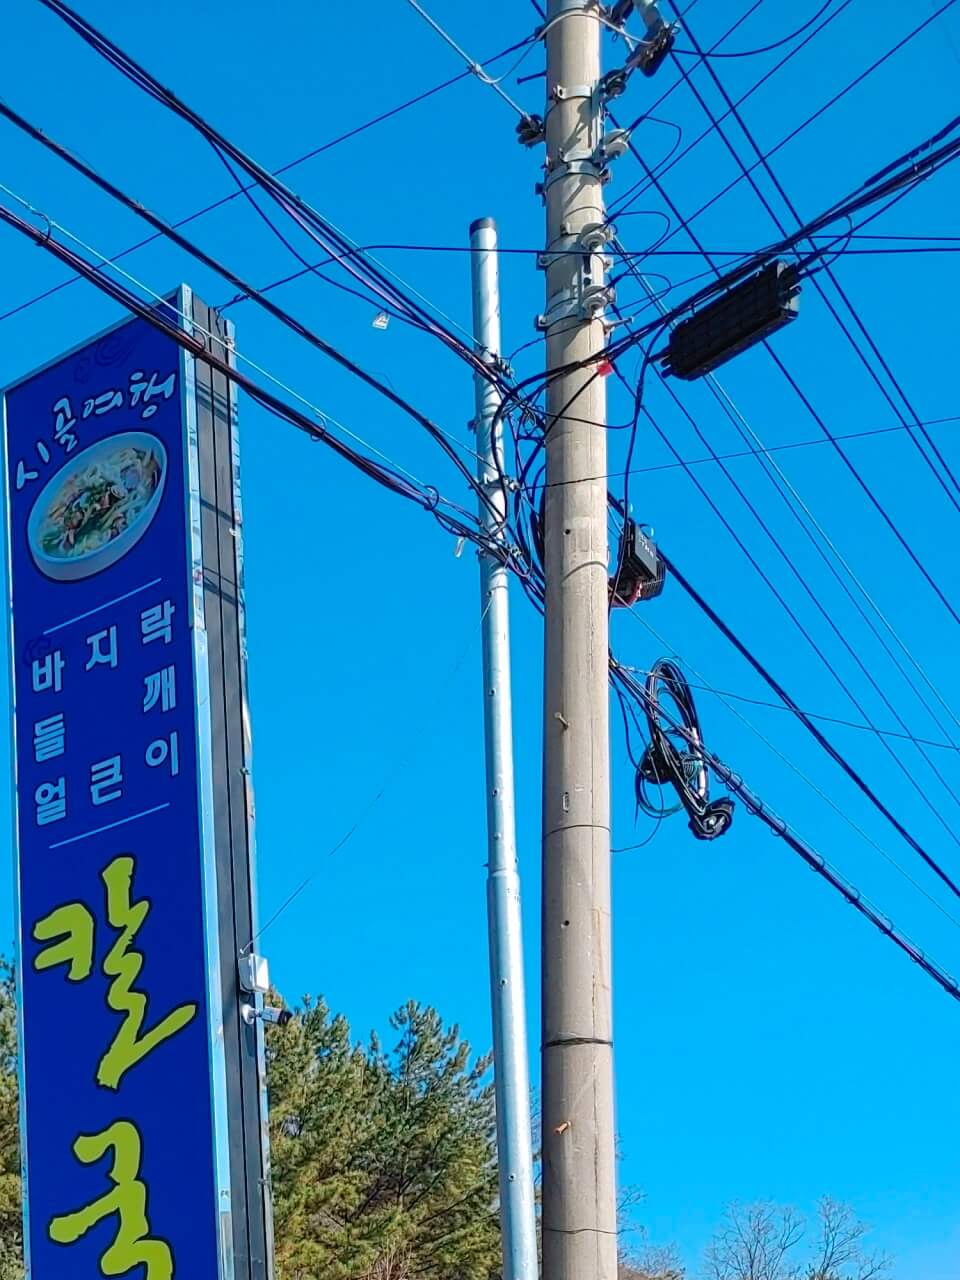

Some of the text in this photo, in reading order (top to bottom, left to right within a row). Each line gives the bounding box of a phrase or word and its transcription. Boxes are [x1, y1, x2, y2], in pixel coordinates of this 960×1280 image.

[15, 371, 176, 490] 시골여행
[31, 599, 176, 693] 바지락
[32, 665, 177, 763] 들깨
[33, 731, 180, 826] 얼큰이
